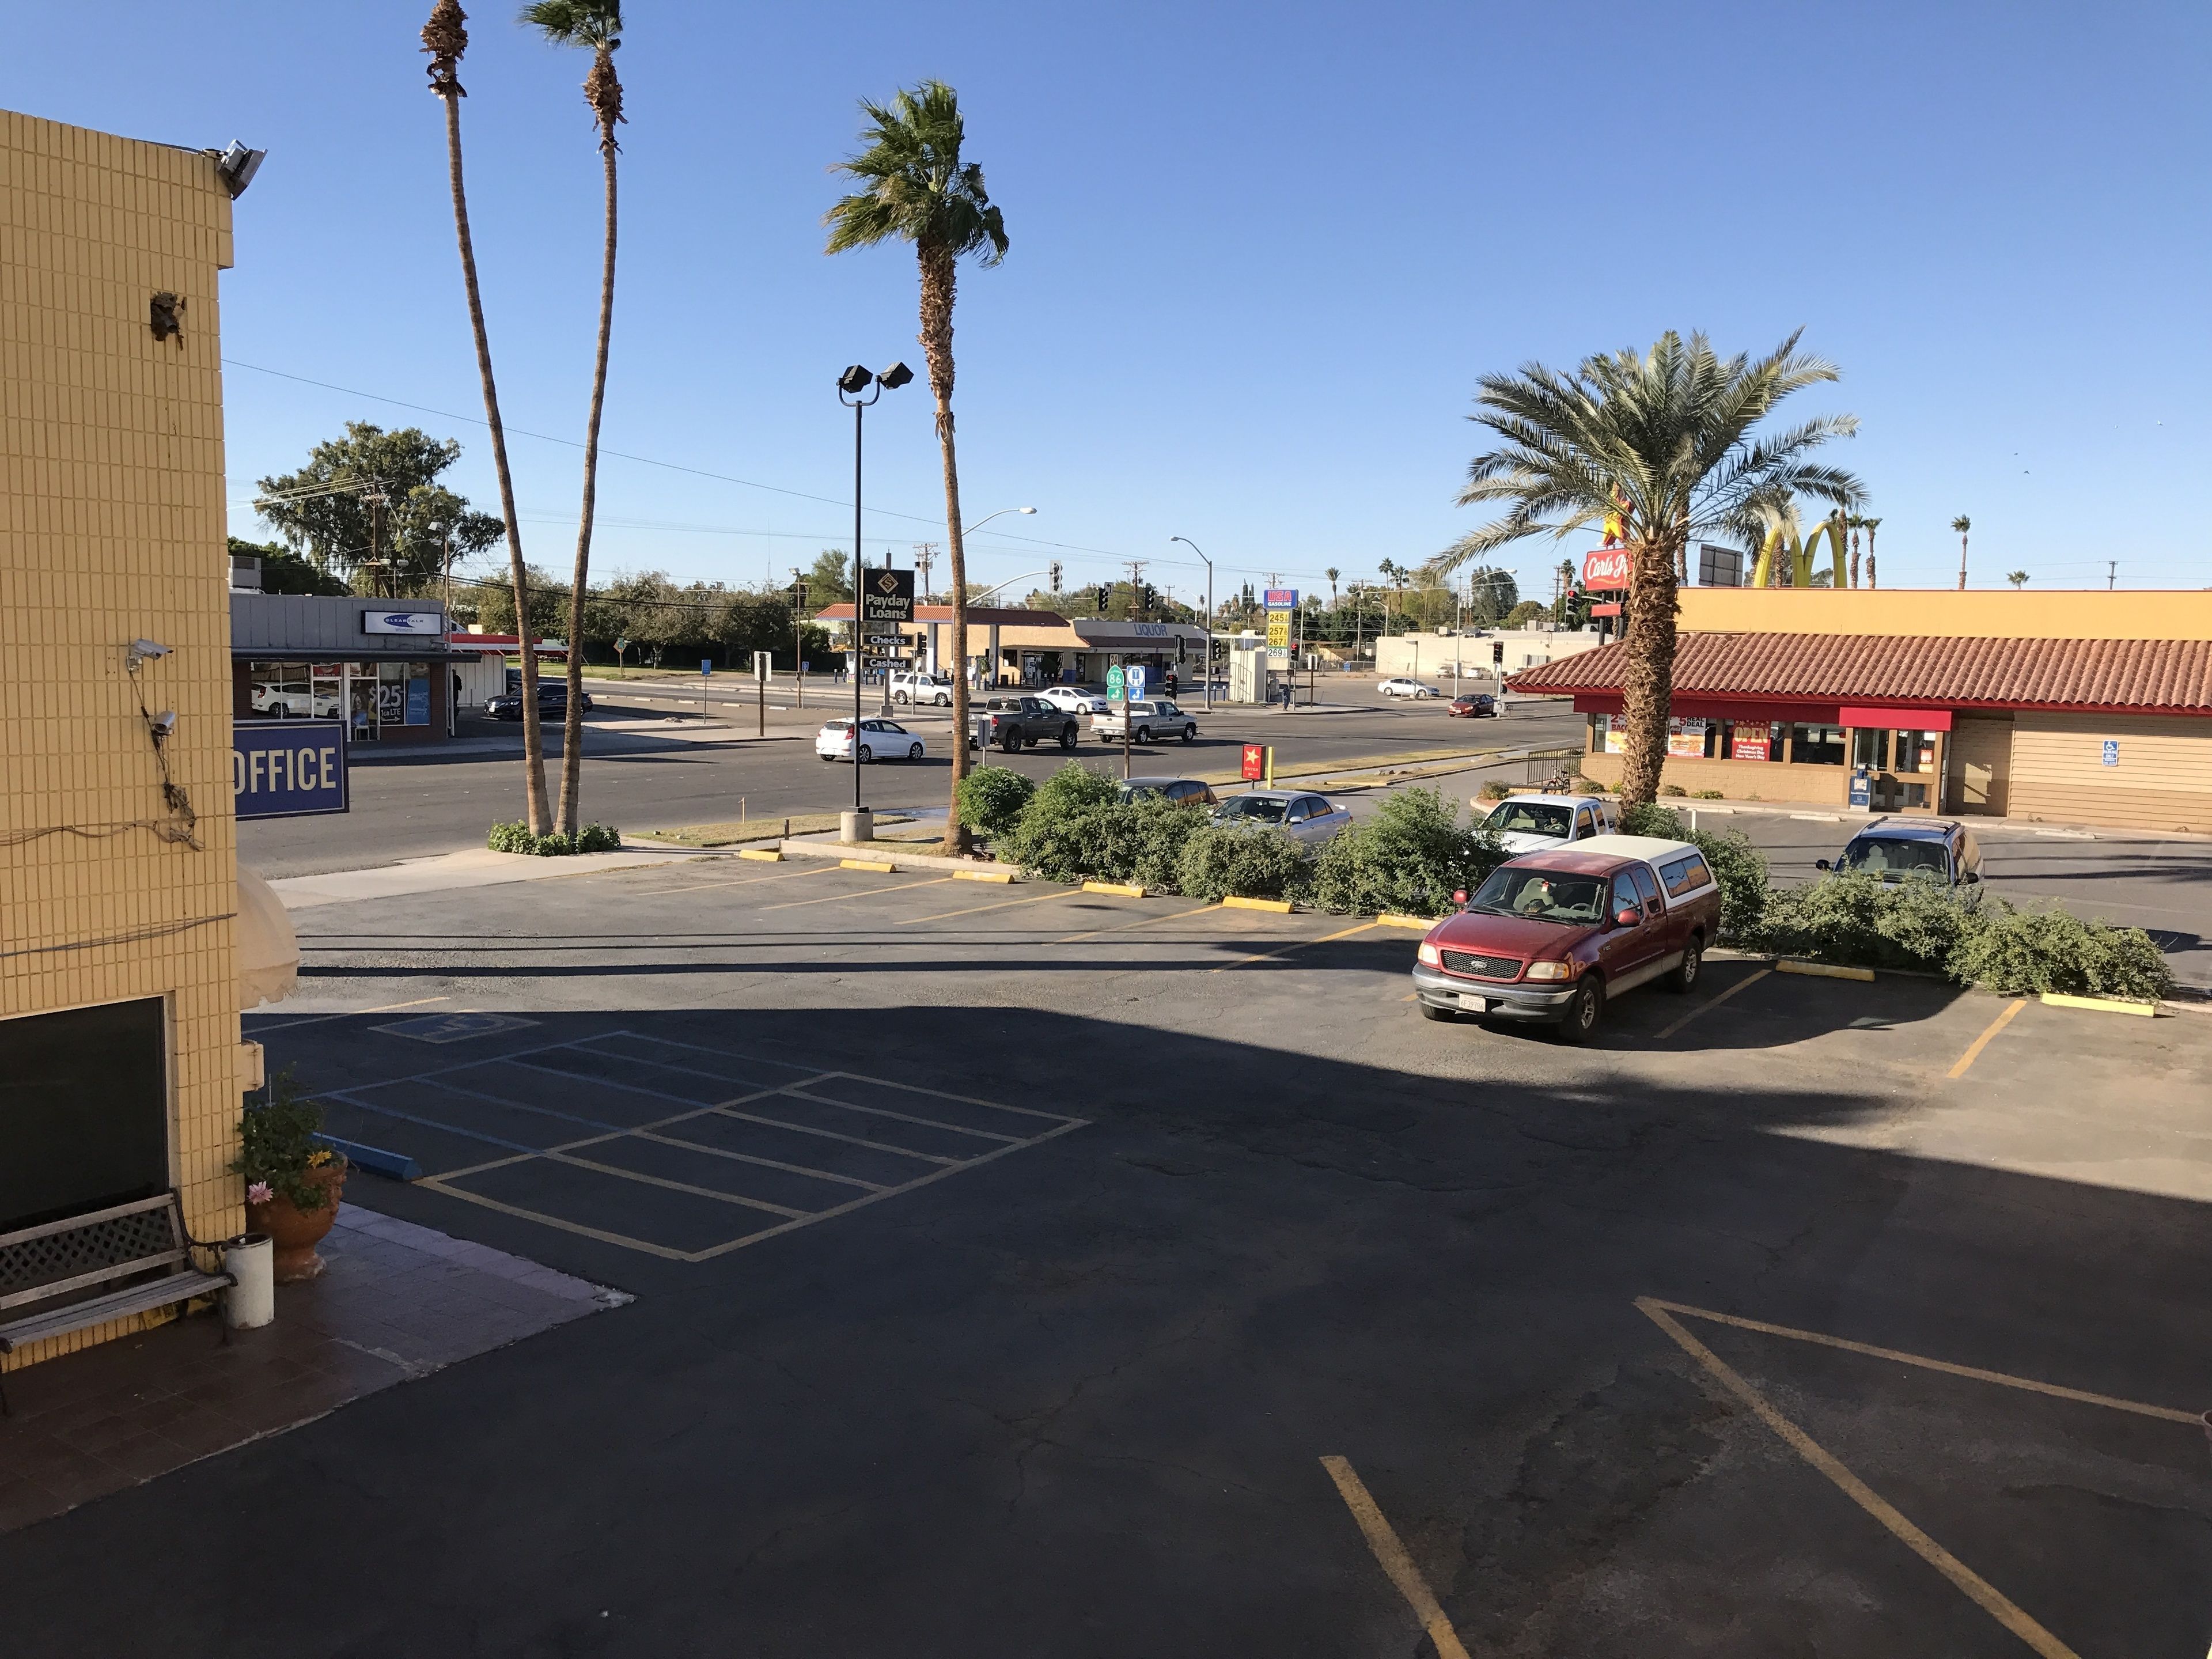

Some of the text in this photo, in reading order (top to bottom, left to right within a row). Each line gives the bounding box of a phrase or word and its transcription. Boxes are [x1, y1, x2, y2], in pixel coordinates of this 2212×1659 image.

[1587, 555, 1613, 579] Carl's
[866, 594, 910, 609] Payday
[1268, 591, 1292, 601] USA
[869, 607, 907, 619] Loans
[1134, 624, 1168, 636] LIQUOR
[870, 636, 906, 645] Checks
[1268, 649, 1282, 657] 269
[869, 659, 906, 668] Cashed
[1109, 674, 1122, 684] 86
[1611, 714, 1619, 722] 2
[1734, 726, 1769, 743] OPEN
[233, 747, 336, 795] OFFICE
